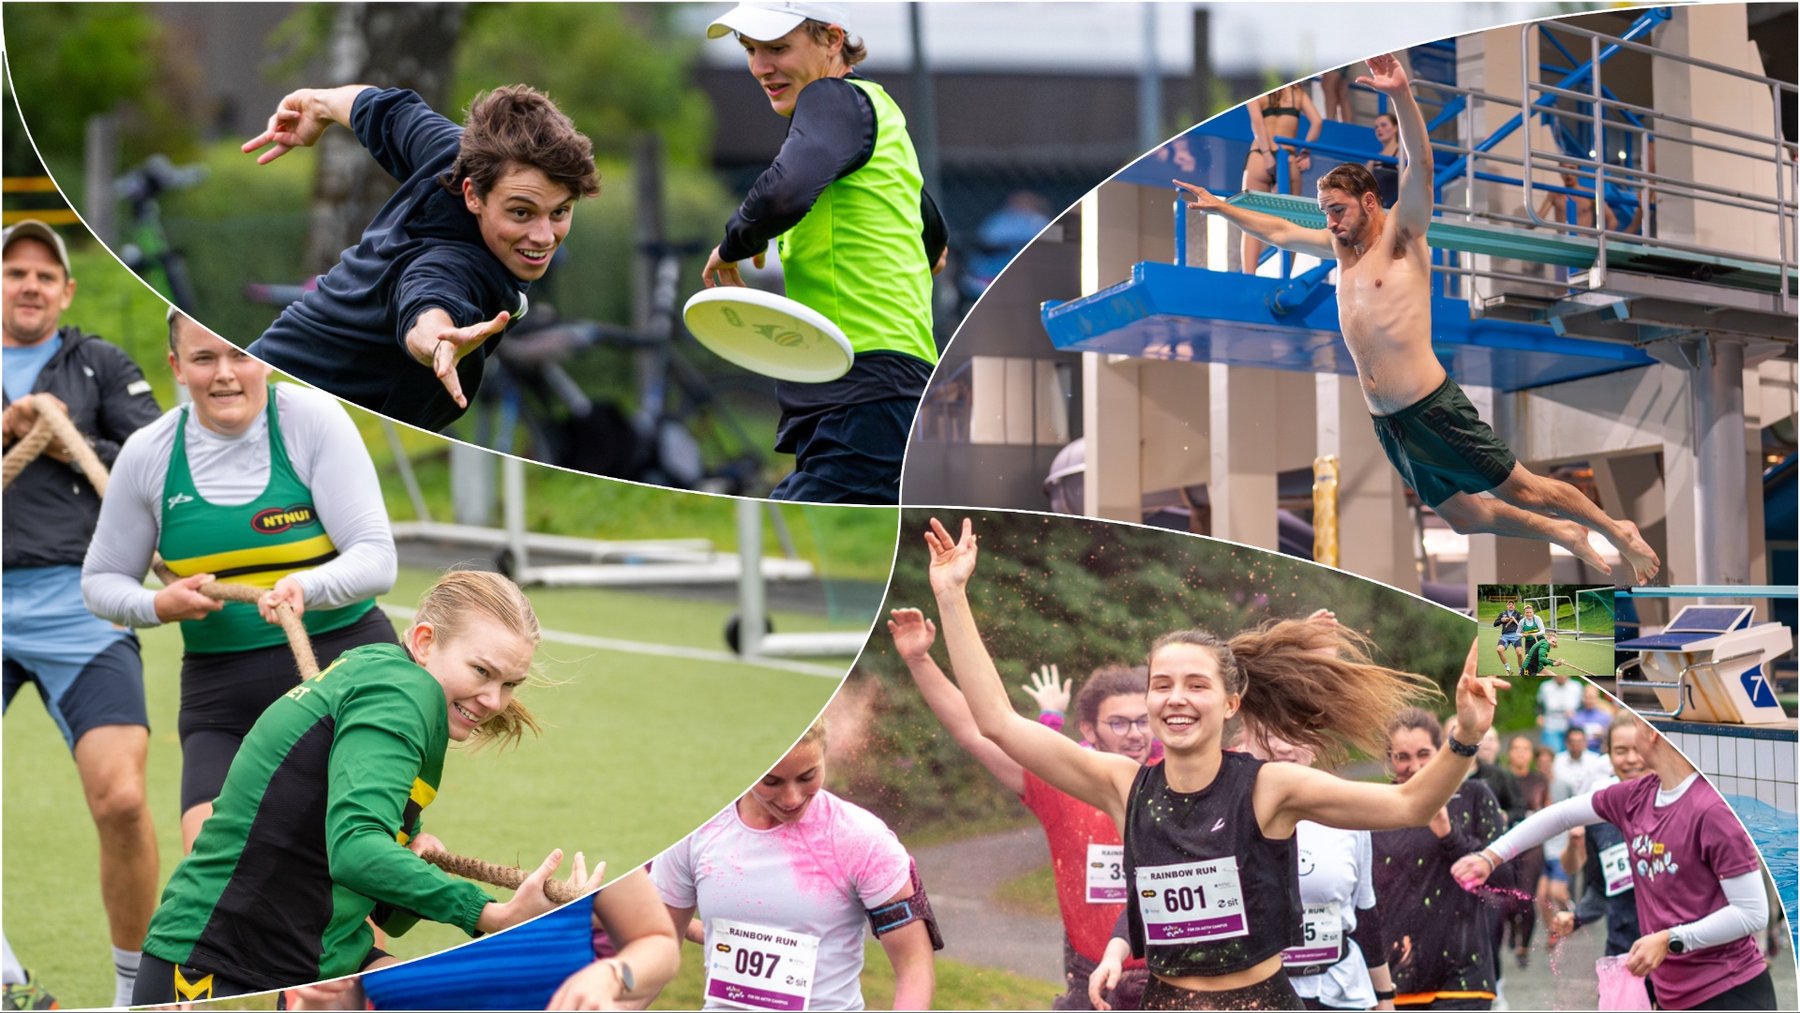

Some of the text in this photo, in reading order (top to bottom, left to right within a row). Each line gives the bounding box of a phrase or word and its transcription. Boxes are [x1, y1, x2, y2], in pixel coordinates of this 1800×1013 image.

[263, 509, 310, 528] NTNUI
[1750, 675, 1763, 702] 7
[1110, 863, 1126, 880] 3
[1150, 866, 1217, 880] RAINBOW RUN
[1163, 885, 1207, 913] 601
[729, 927, 798, 947] RAINBOW RUN
[735, 948, 781, 979] 097
[795, 977, 807, 987] sit
